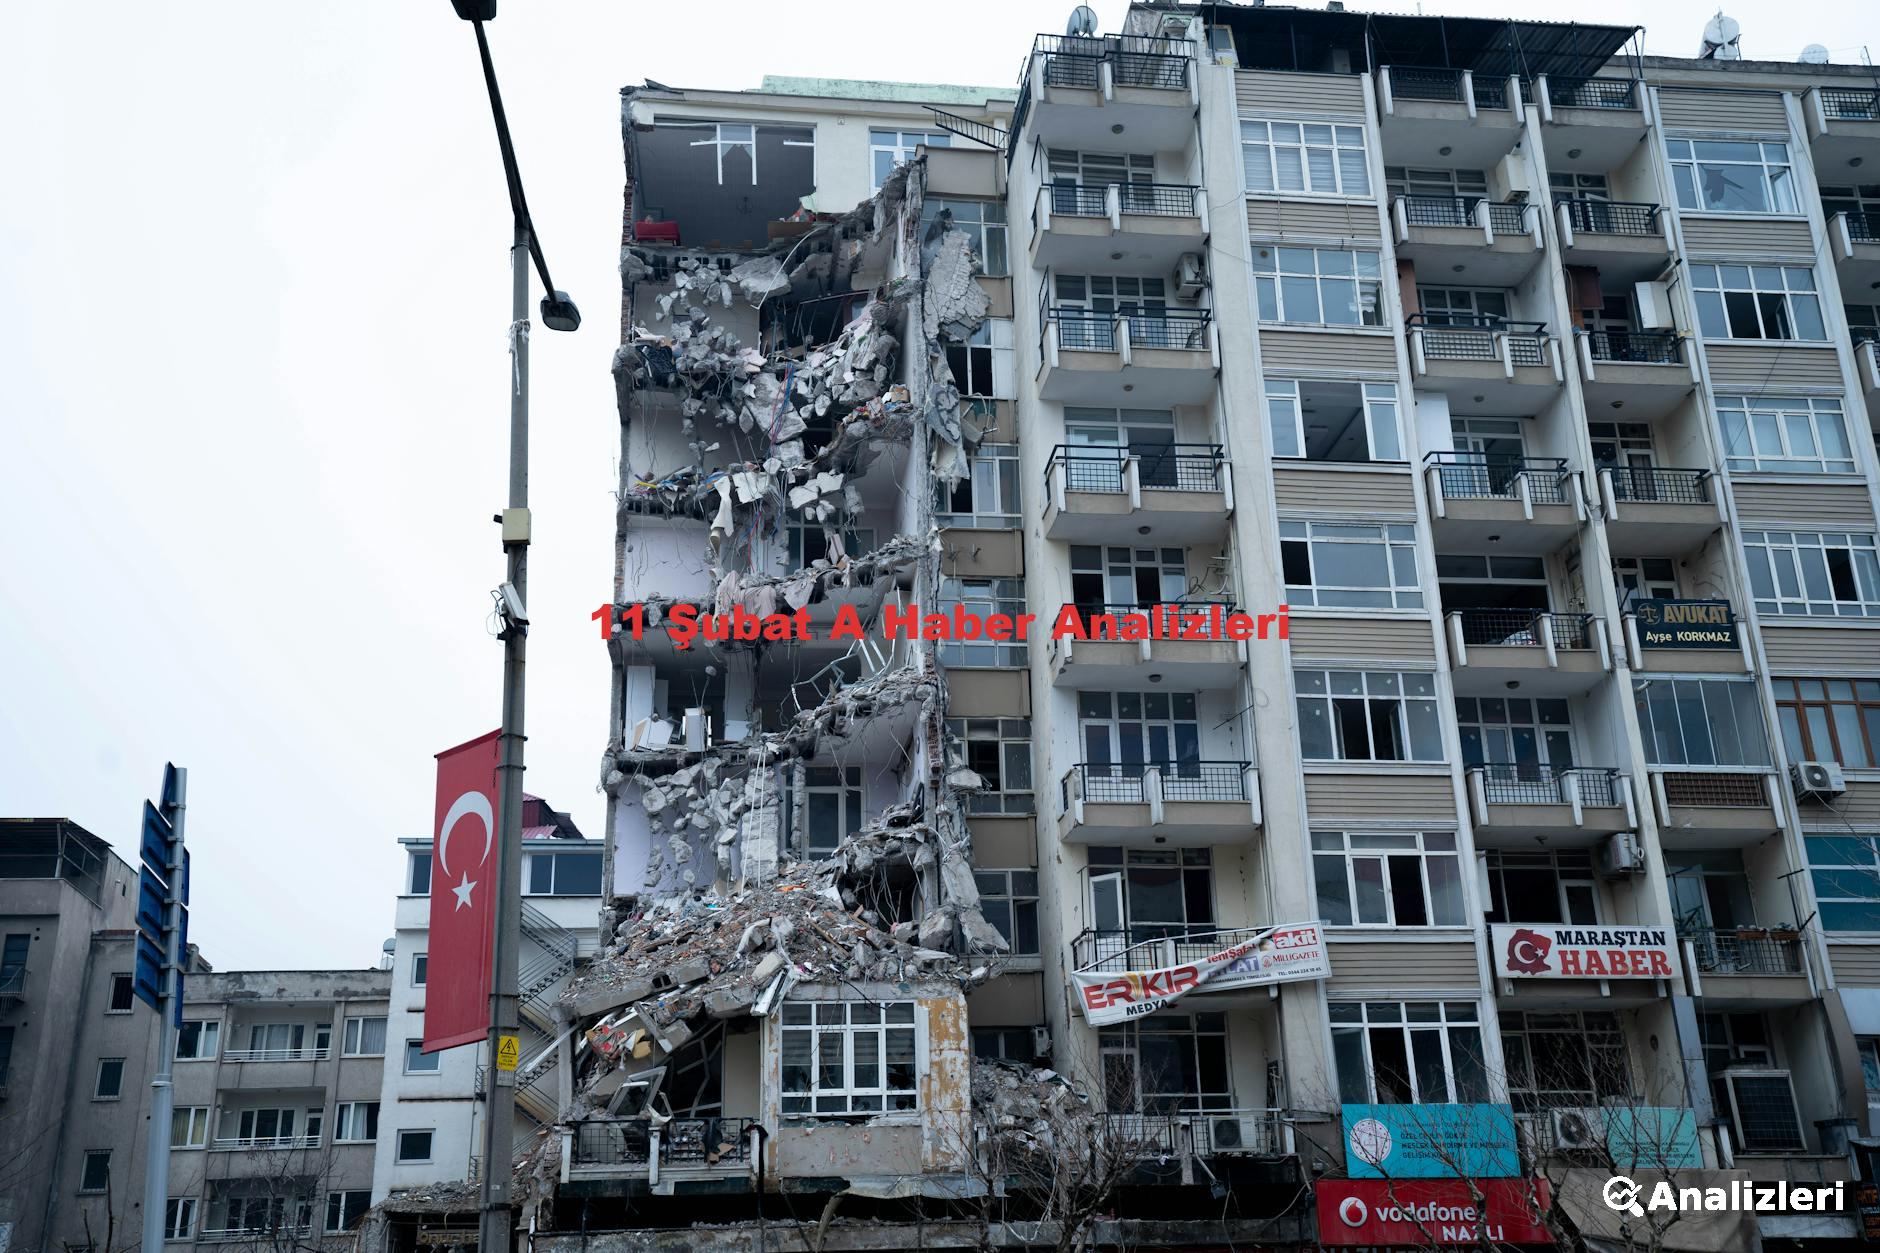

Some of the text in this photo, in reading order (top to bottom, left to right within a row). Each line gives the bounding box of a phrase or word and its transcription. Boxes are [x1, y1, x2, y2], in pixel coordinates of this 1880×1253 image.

[1664, 605, 1729, 624] AVUKAT
[1646, 631, 1731, 643] Ayşe KORKMAZ
[1274, 930, 1316, 949] akit
[1555, 931, 1666, 948] MARAŞTAN
[1558, 950, 1672, 976] HABER
[1126, 999, 1168, 1016] MEDYA
[1375, 1201, 1477, 1221] vodafone
